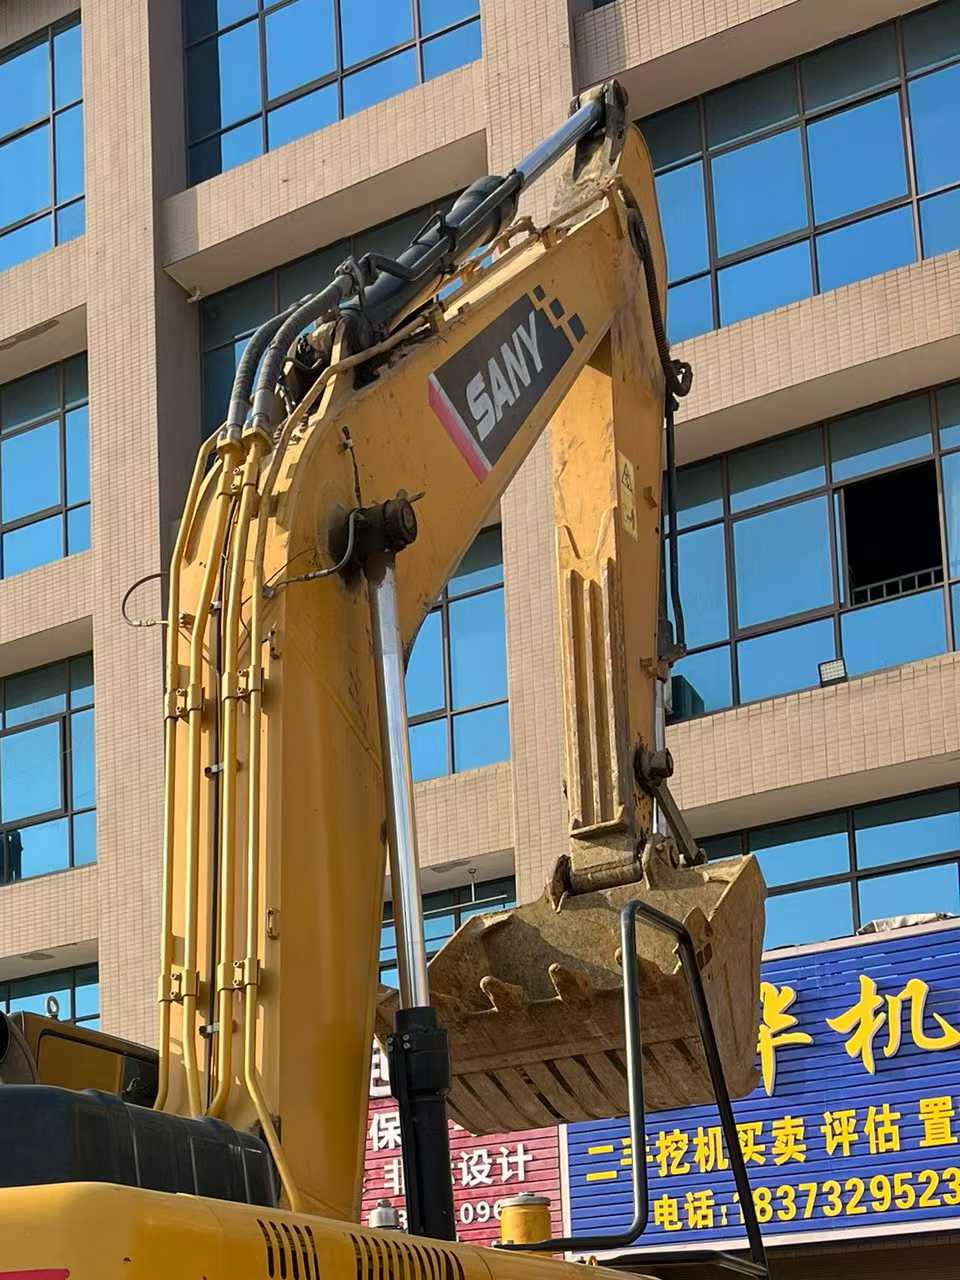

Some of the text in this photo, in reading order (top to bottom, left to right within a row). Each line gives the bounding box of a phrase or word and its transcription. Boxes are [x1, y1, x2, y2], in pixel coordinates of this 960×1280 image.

[466, 310, 543, 442] SANY
[820, 1103, 901, 1157] 评估
[384, 1143, 533, 1196] 非设计
